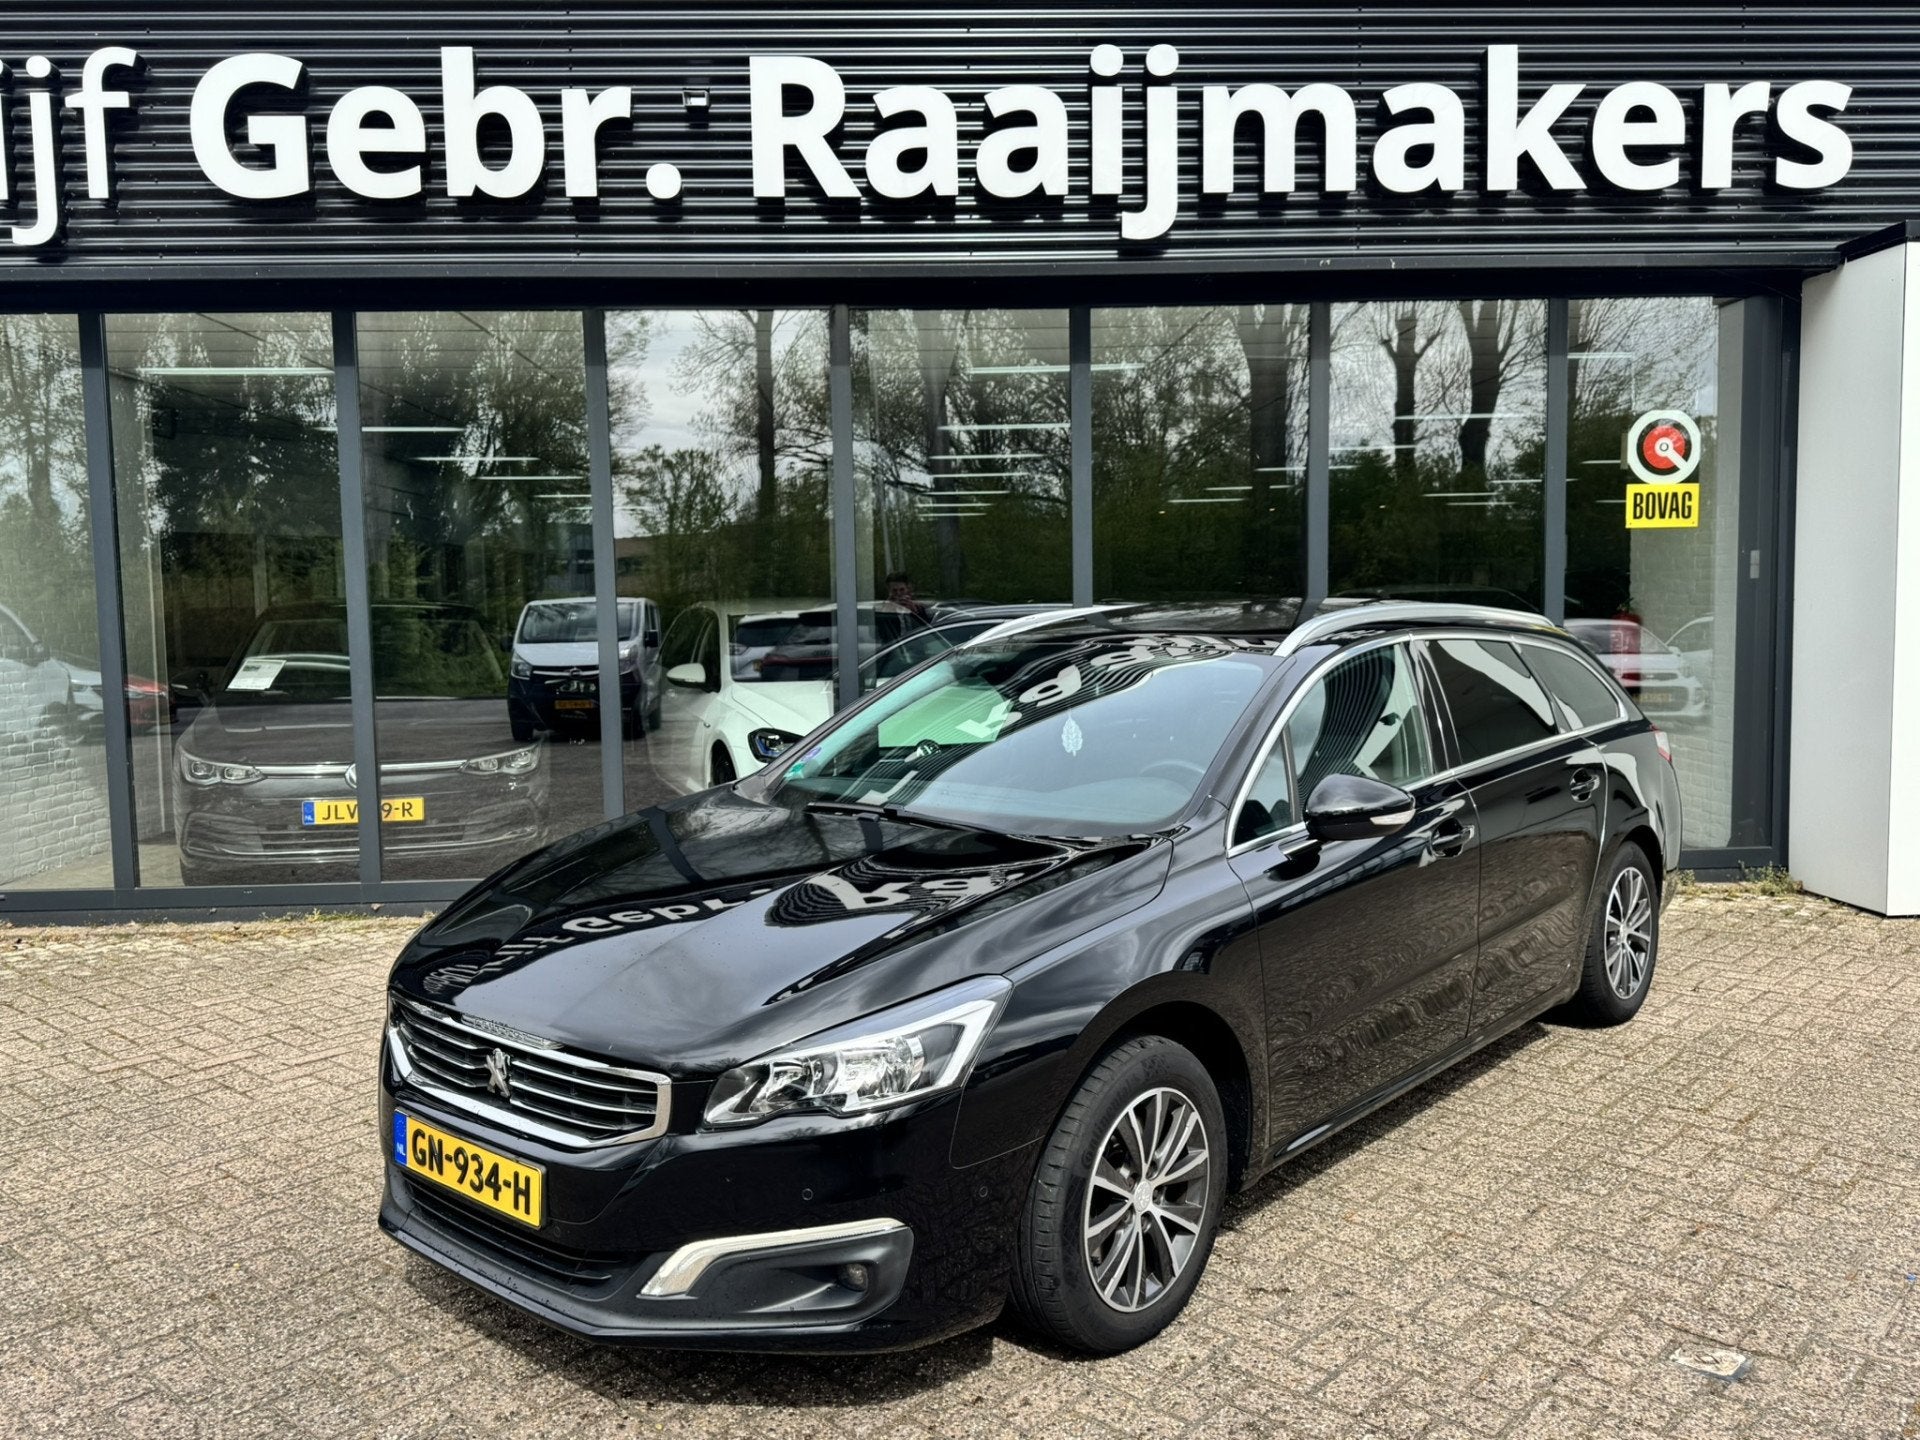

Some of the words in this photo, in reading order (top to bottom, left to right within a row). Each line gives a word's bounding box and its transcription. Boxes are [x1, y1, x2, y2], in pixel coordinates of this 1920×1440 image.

[0, 46, 137, 246] jf
[190, 46, 683, 199] Gebr.
[749, 44, 1854, 240] Raaijmakers
[1632, 491, 1692, 520] BOVAG
[411, 1127, 531, 1216] GN-934-H
